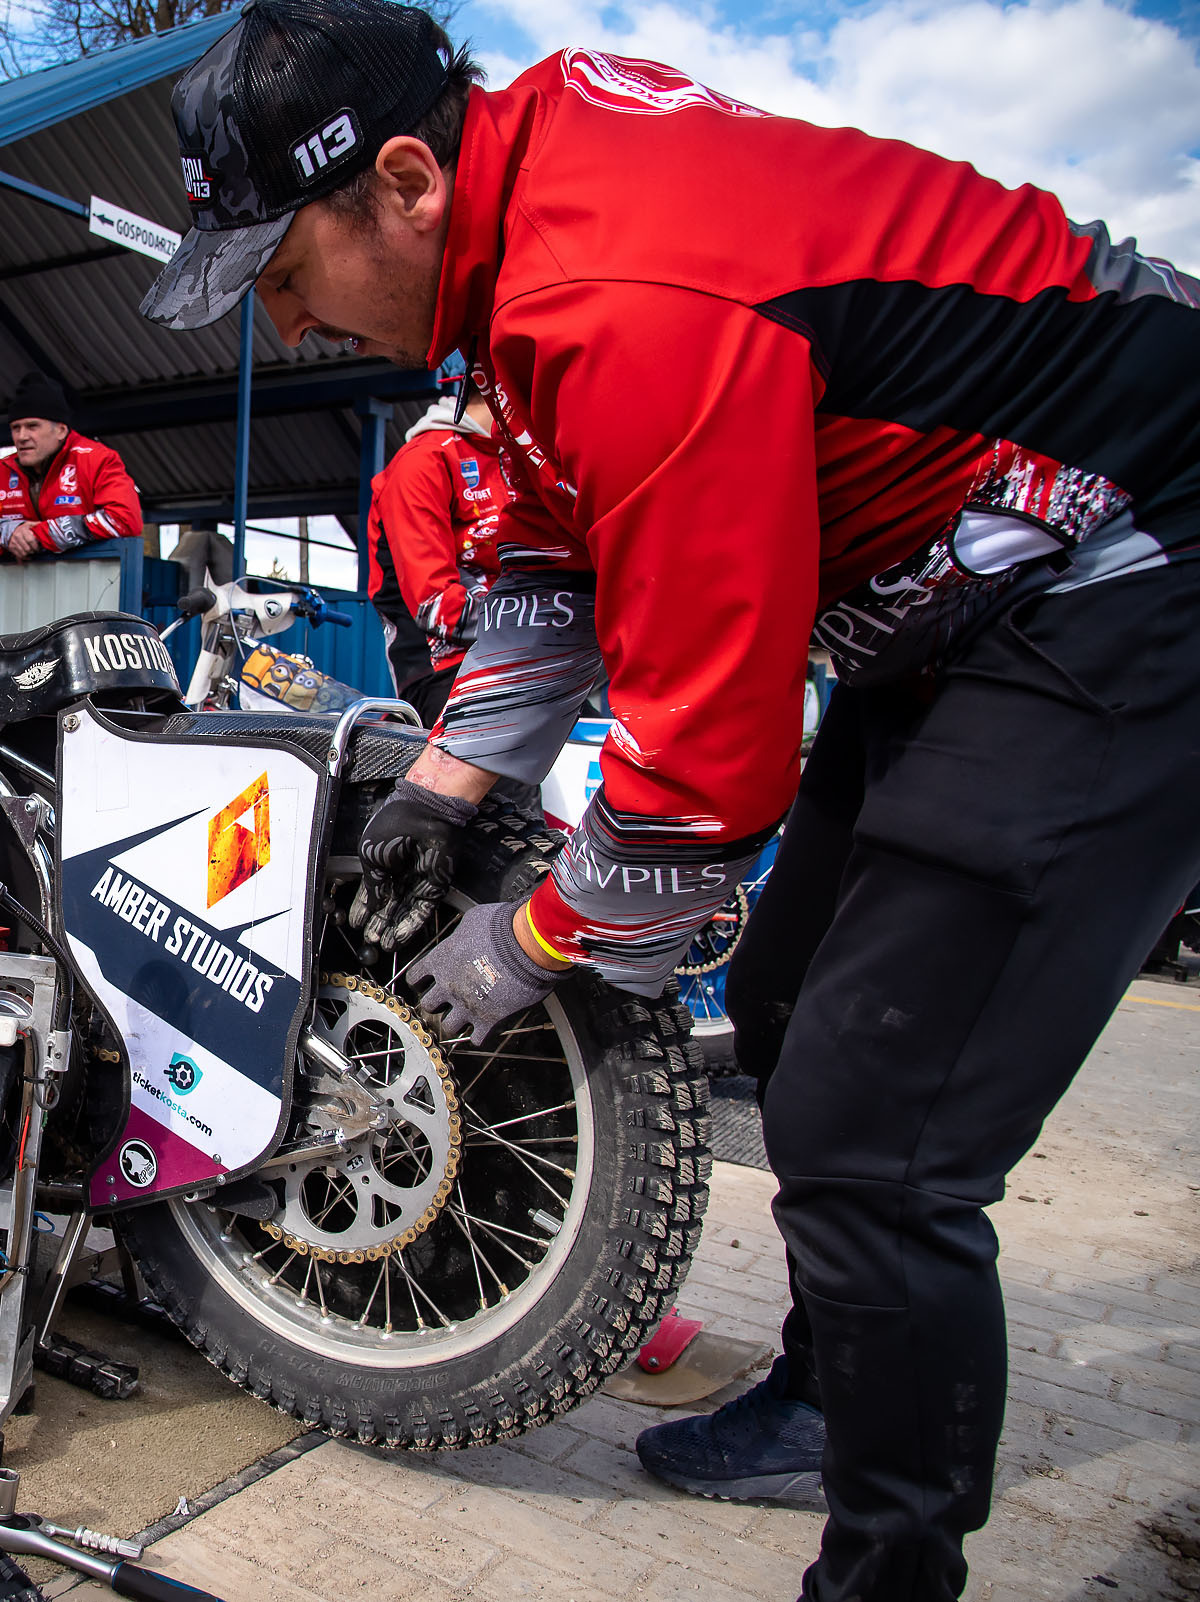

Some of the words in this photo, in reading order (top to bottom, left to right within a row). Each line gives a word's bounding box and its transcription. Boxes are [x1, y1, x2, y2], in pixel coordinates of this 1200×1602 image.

[294, 114, 356, 178] 113
[192, 181, 211, 198] 113
[90, 866, 171, 942] AMBER
[164, 915, 274, 1013] STUDIOS
[132, 1071, 213, 1136] ticketkosta.com
